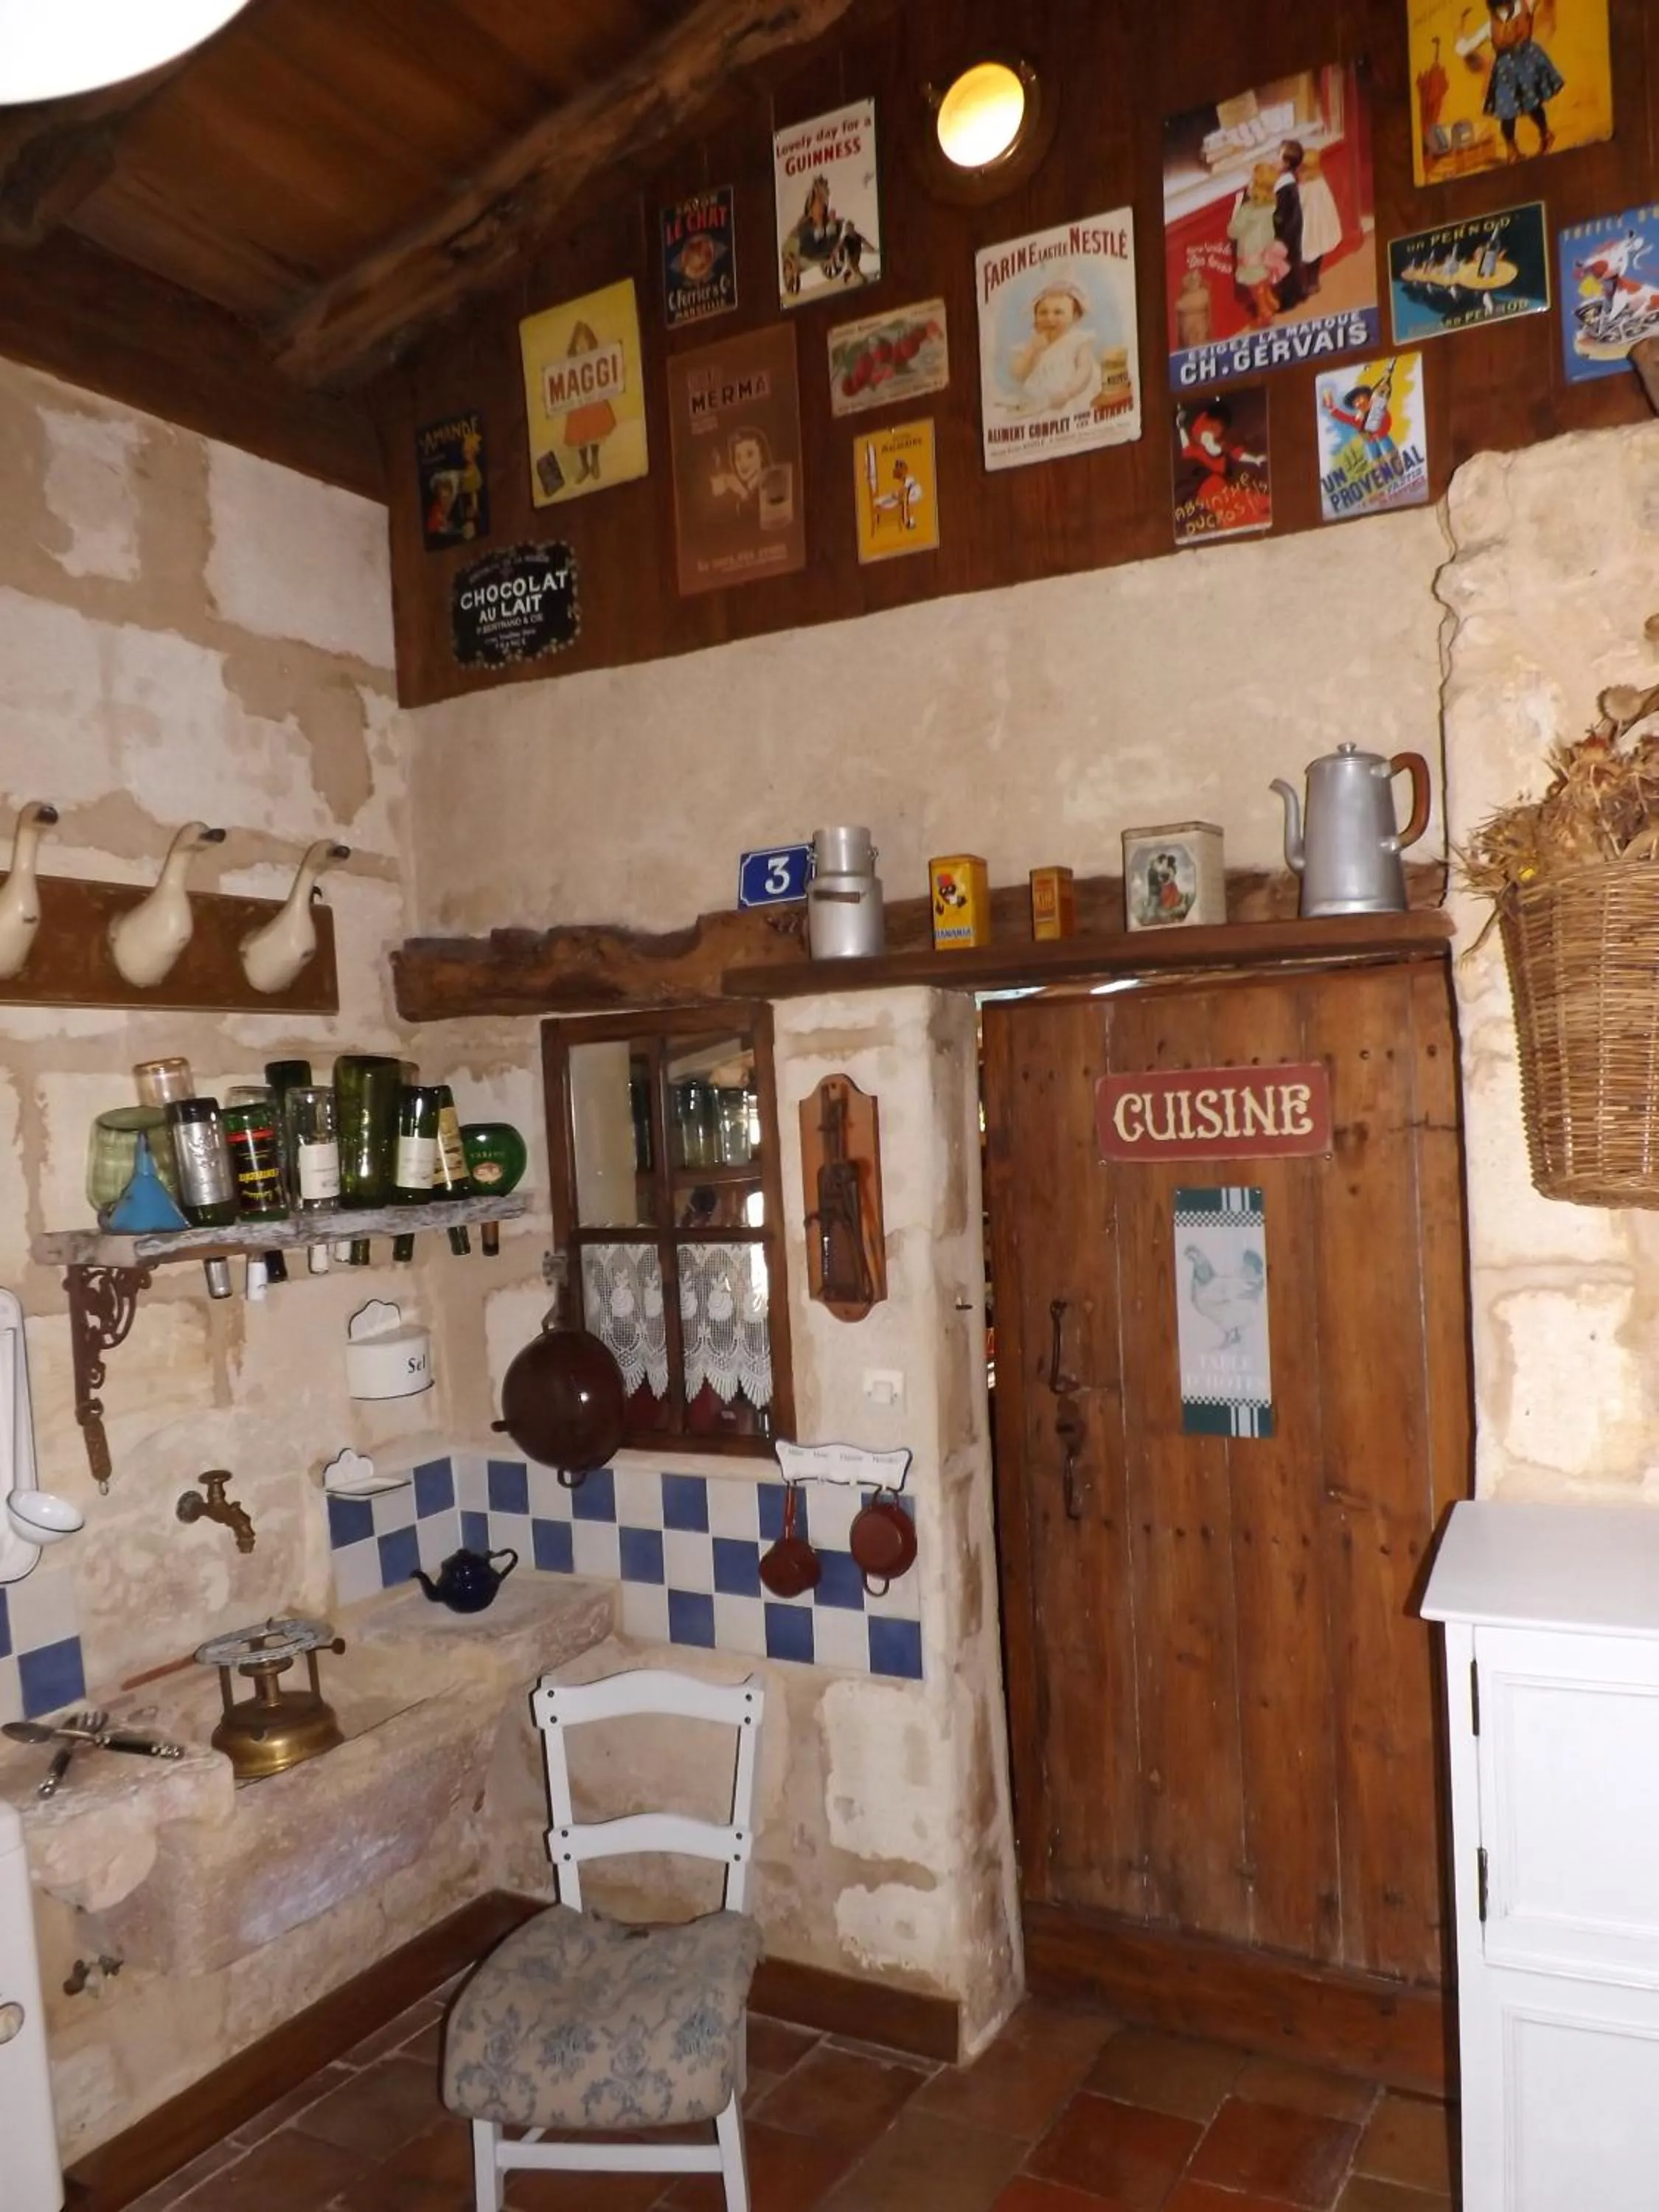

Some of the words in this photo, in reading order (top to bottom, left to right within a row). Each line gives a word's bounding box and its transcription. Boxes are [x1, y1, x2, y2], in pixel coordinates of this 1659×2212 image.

[776, 135, 812, 159] Lovely
[816, 127, 838, 141] day
[842, 118, 859, 133] for
[785, 136, 861, 177] GUINNESS
[1430, 217, 1511, 246] PERNOD
[984, 242, 1037, 305] FARINE
[1069, 226, 1128, 260] NESTLÉ
[1233, 322, 1368, 372] GERVAIS
[1259, 330, 1277, 344] LA
[1285, 312, 1360, 337] MARQUE
[549, 354, 618, 405] MAGGI
[987, 425, 1024, 442] ALIMENT
[1029, 417, 1070, 438] COMPLET
[1321, 466, 1347, 493] UN
[460, 570, 568, 610] CHOCOLAT
[479, 607, 496, 623] AU
[501, 594, 543, 616] LAIT
[765, 855, 790, 894] 3
[1112, 1083, 1315, 1142] CUISINE
[407, 1354, 425, 1373] Sel
